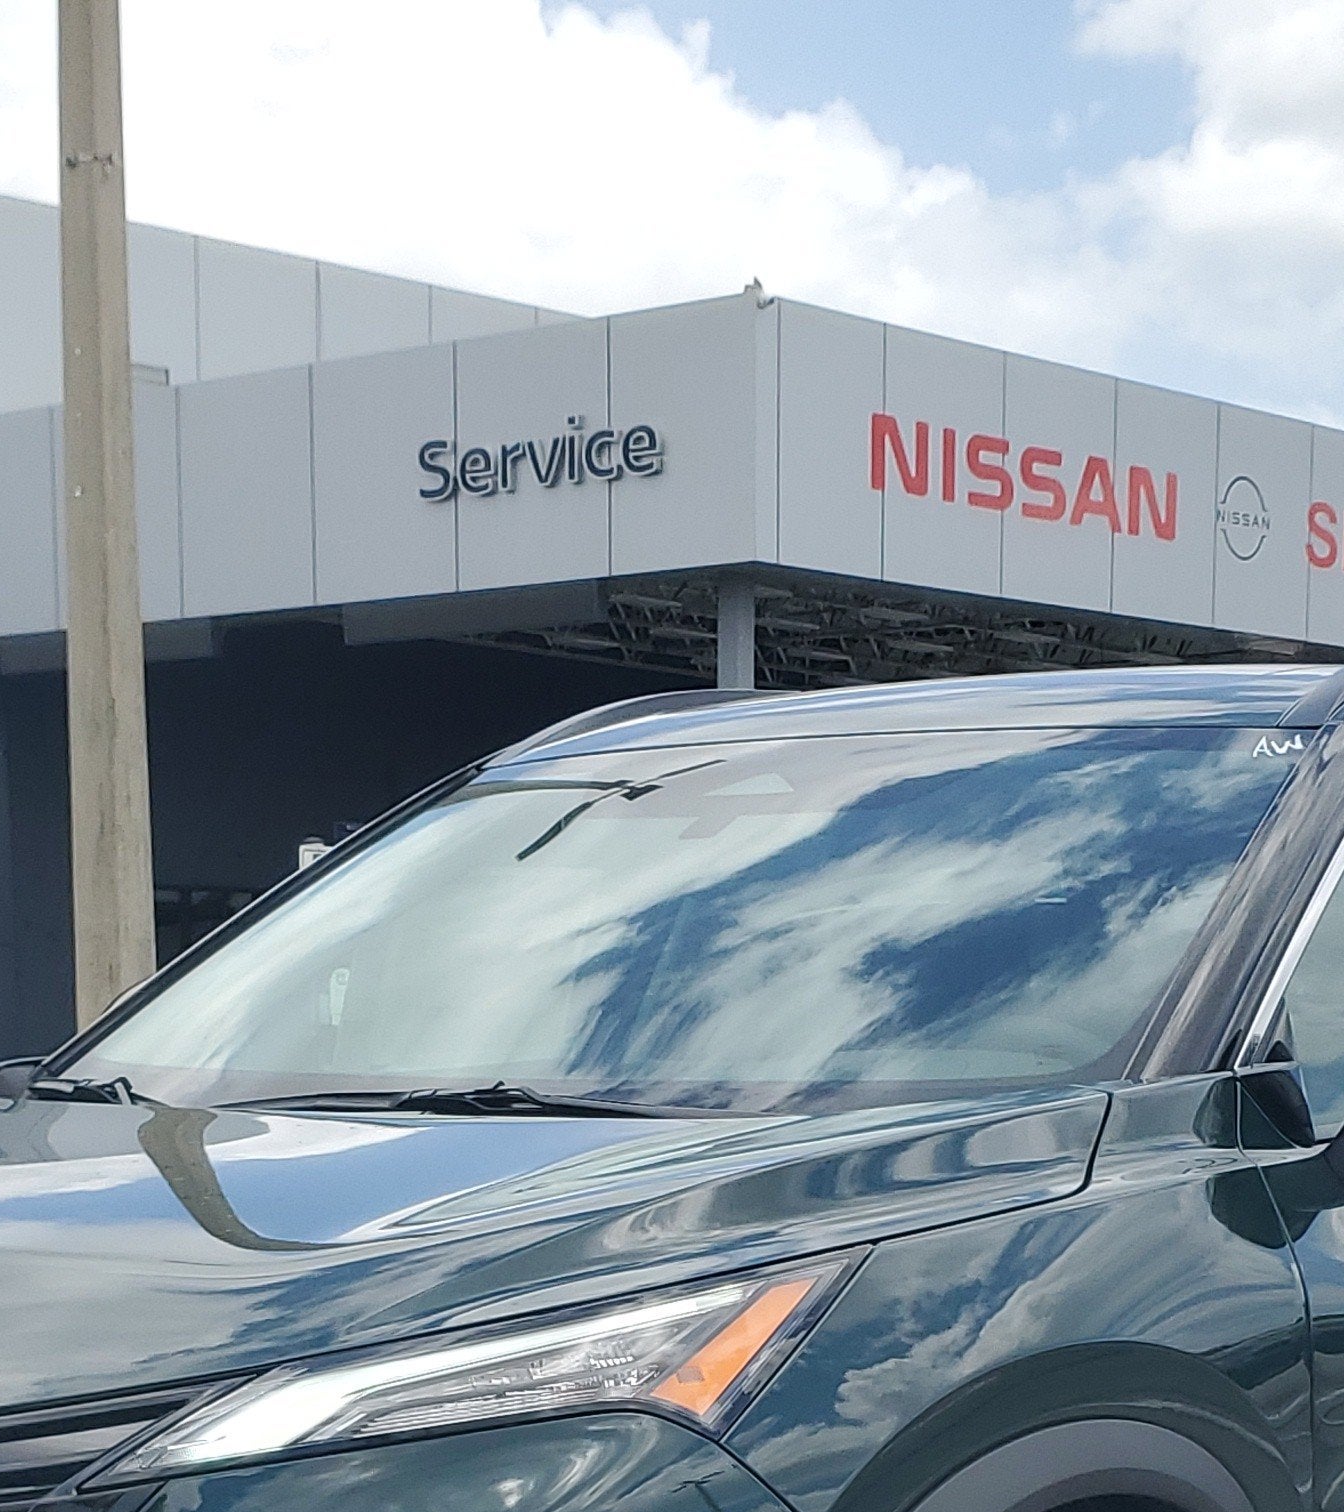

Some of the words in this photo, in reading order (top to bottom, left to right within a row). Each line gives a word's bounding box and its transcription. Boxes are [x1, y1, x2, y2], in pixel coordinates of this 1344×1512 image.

[418, 415, 663, 502] Service
[870, 411, 1178, 541] NISSAN
[1216, 508, 1271, 531] NISSAN
